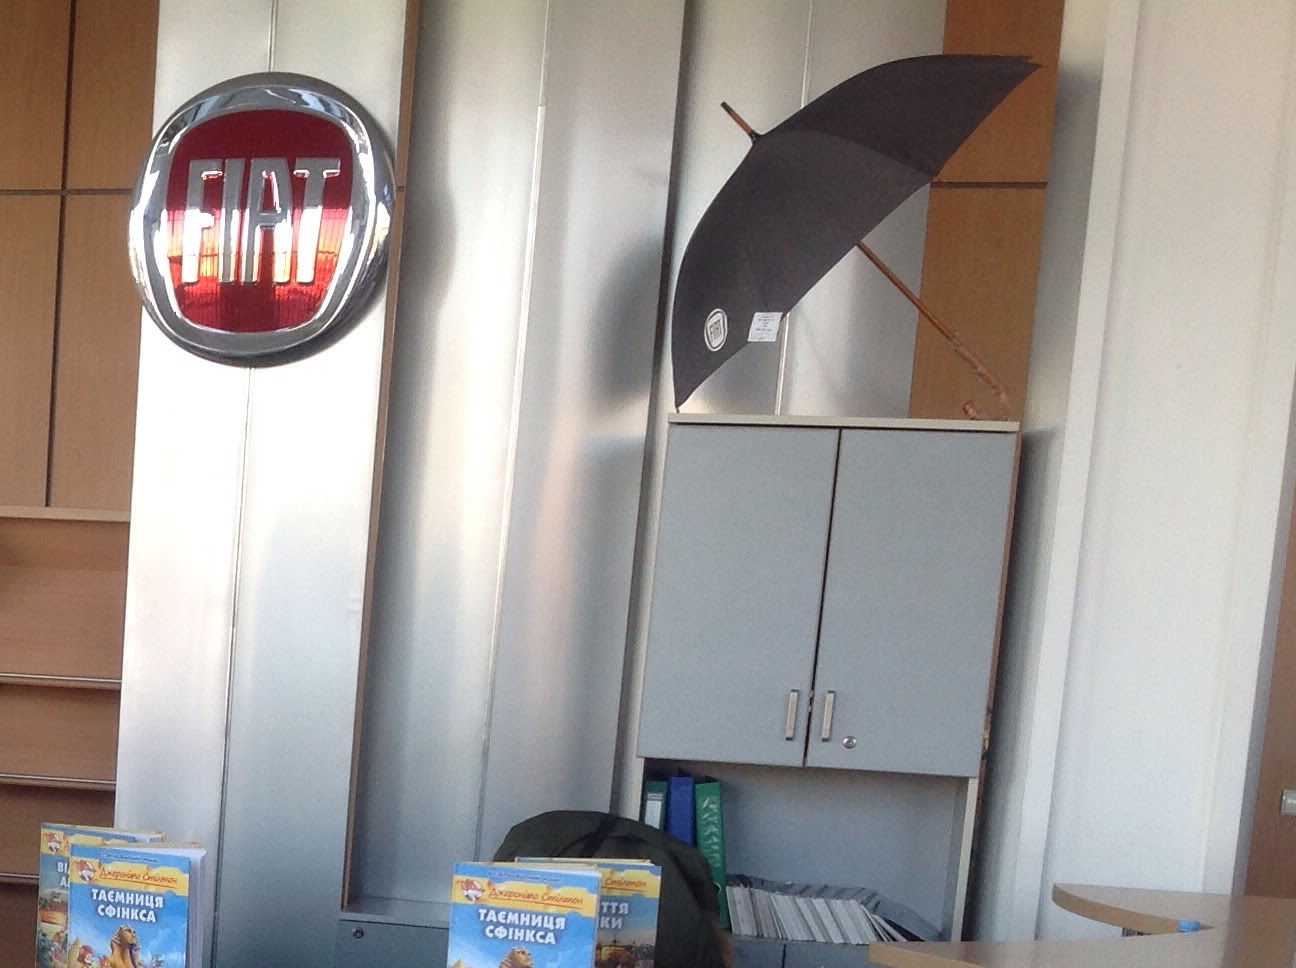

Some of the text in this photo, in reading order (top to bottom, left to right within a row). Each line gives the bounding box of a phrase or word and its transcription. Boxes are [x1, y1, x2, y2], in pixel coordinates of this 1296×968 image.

[181, 156, 342, 286] FIAT
[91, 888, 164, 908] ТАЄМНИЦЯ
[97, 905, 157, 923] СФІНКСА
[478, 908, 567, 930] ТАЄМНИЦЯ
[485, 925, 557, 945] СФІНКСА
